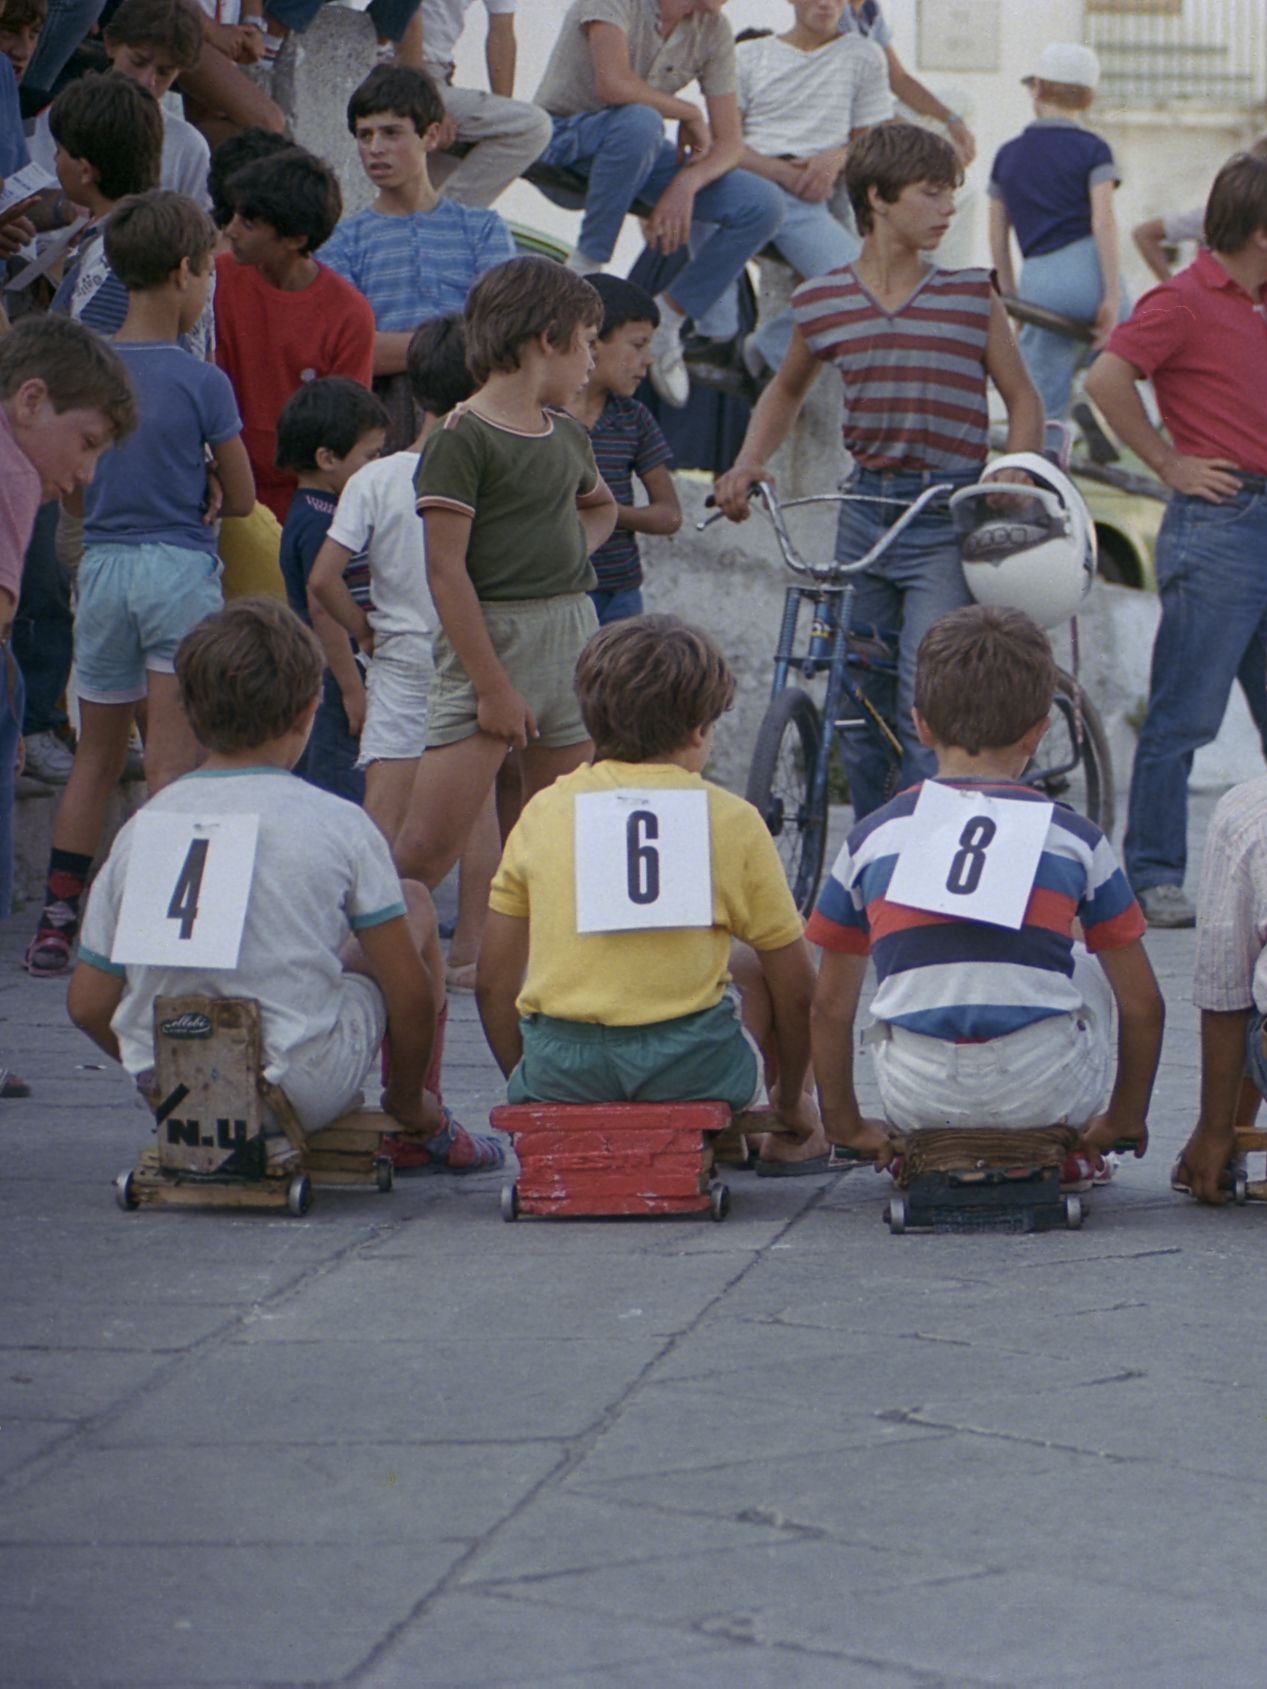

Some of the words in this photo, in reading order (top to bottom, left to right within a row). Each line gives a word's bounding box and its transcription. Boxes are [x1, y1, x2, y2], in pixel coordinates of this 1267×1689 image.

[167, 838, 209, 940] 4
[627, 810, 660, 905] 6
[946, 816, 996, 895] 8
